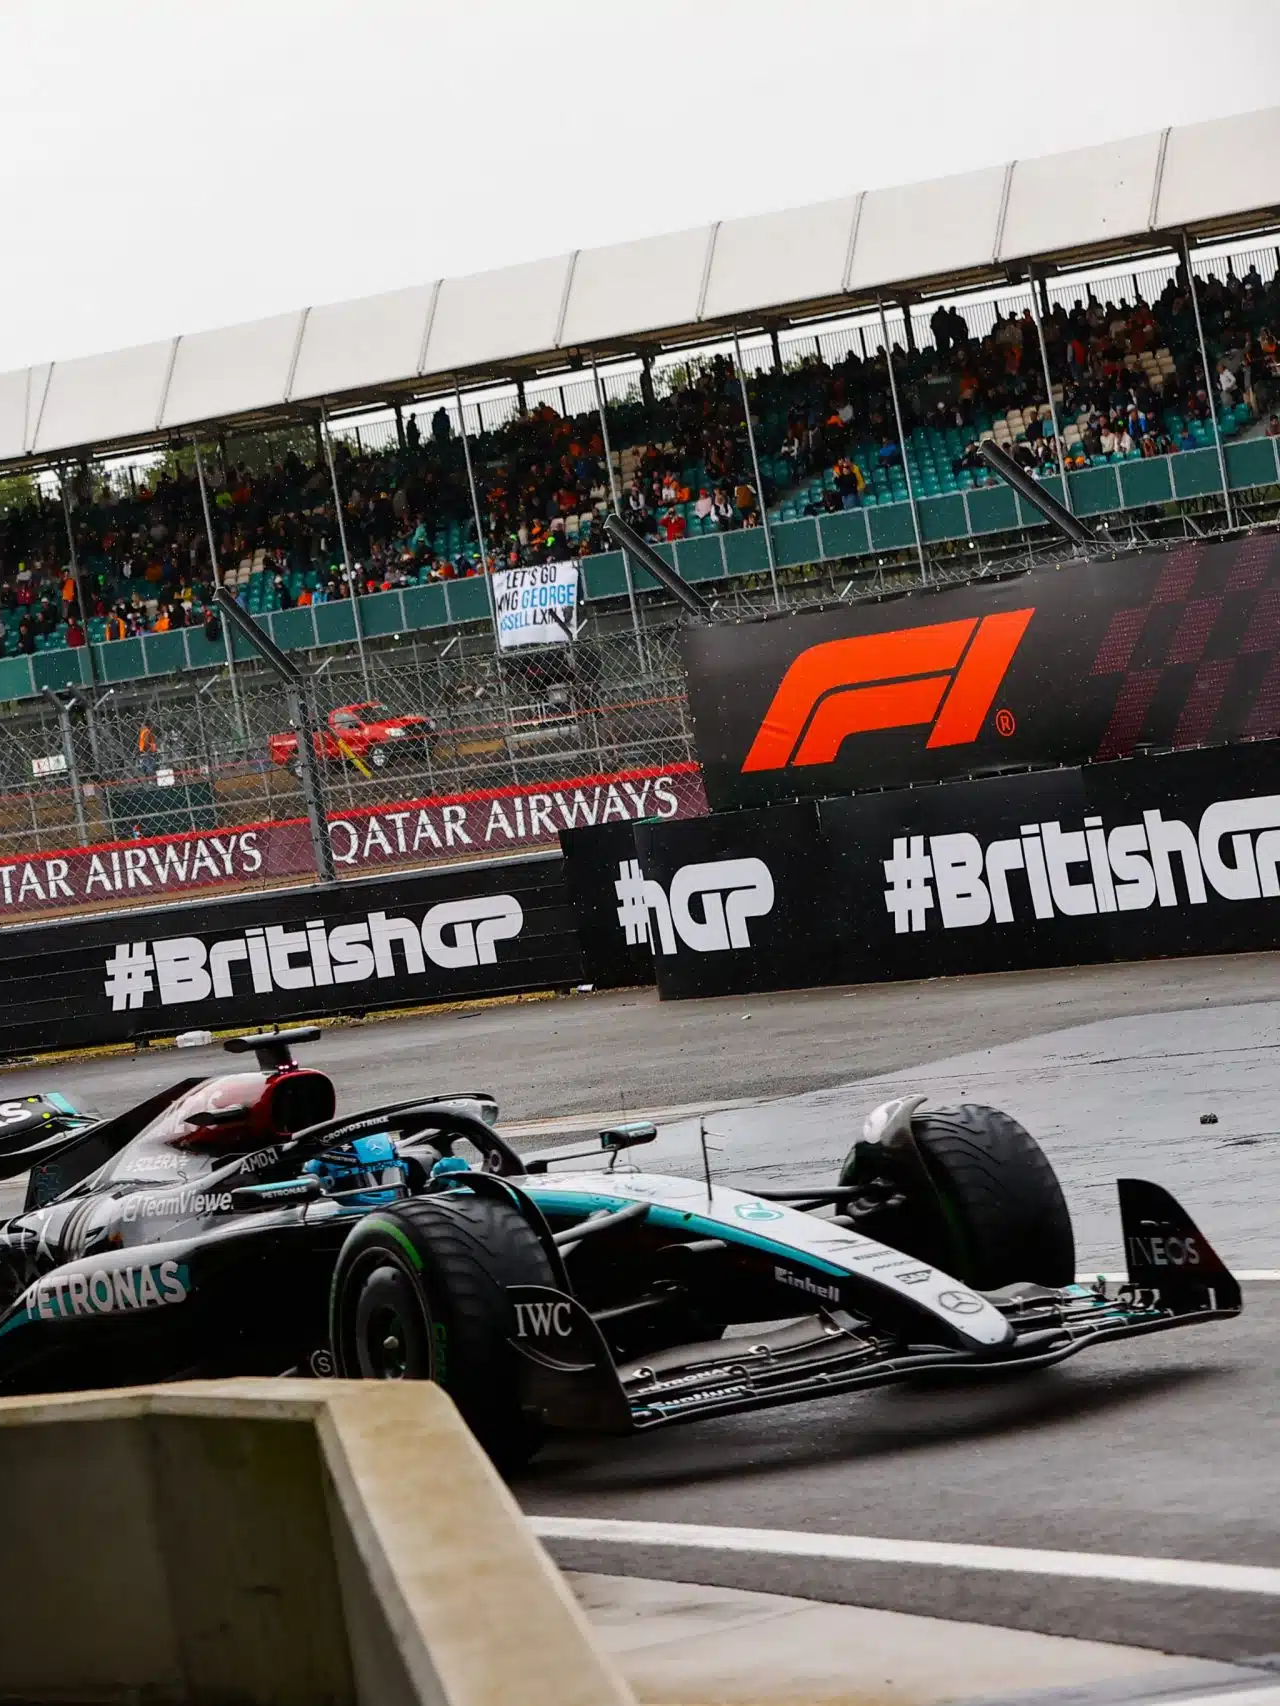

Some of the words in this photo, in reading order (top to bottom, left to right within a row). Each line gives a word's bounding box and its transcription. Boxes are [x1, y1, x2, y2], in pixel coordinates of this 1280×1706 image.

[506, 567, 538, 590] LET'S
[540, 565, 557, 585] GO
[521, 583, 575, 609] GEORGE
[741, 607, 1035, 773] F1
[327, 804, 473, 864] QATAR
[484, 776, 679, 842] AIRWAYS
[85, 831, 262, 894] AIRWAYS
[104, 894, 524, 1012] #BritishGP
[322, 1115, 390, 1143] CROWDSTRIKE
[240, 1151, 270, 1175] AMD
[140, 1189, 234, 1218] TeamViewe
[262, 1185, 308, 1199] PETRONAS
[1128, 1236, 1200, 1266] INEOS
[26, 1260, 187, 1321] PETRONAS
[774, 1266, 841, 1302] Einhell
[514, 1302, 573, 1337] IWC
